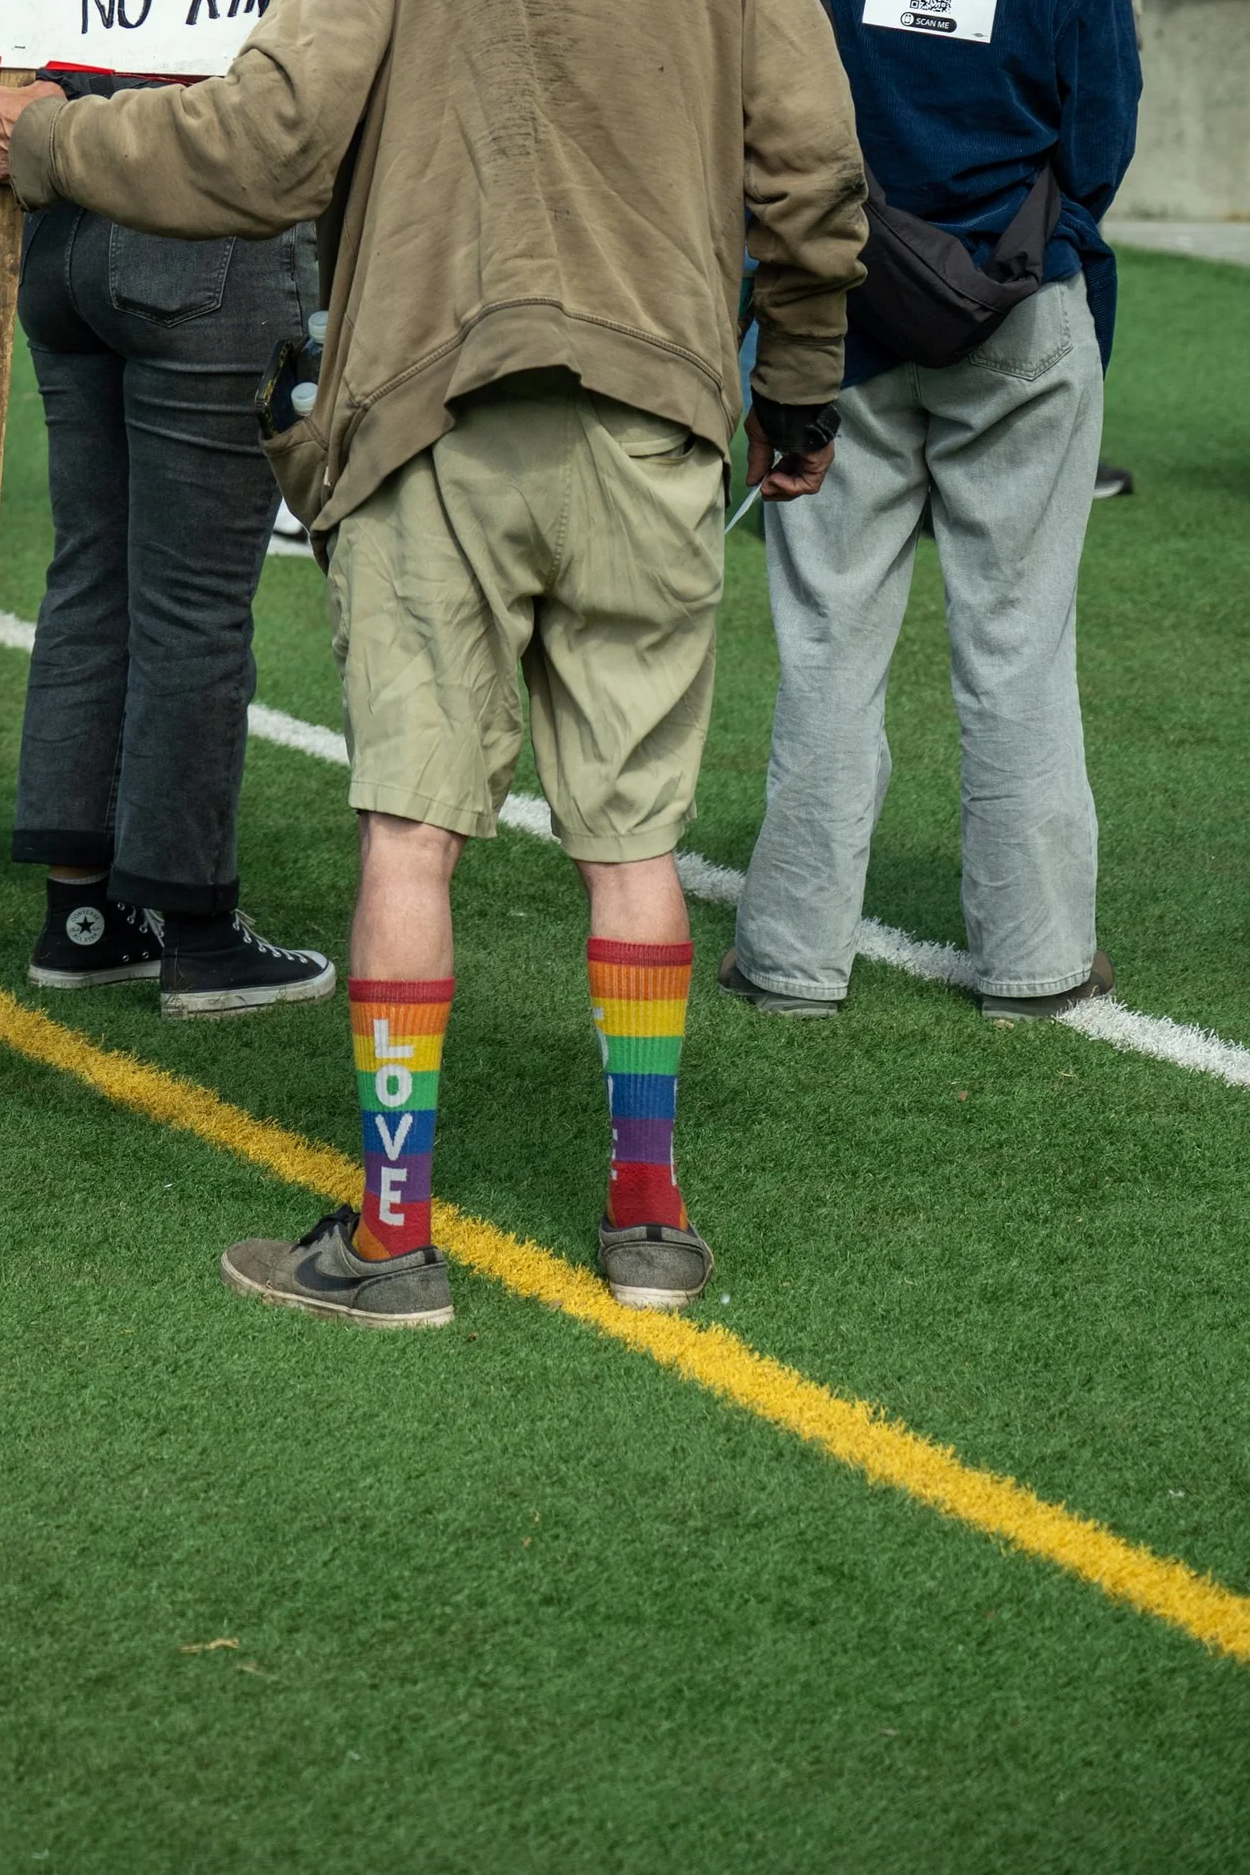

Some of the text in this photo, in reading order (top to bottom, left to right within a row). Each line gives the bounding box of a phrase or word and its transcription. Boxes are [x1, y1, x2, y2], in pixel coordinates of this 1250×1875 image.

[915, 17, 950, 30] SCAN ME
[373, 1019, 414, 1226] LOVE
